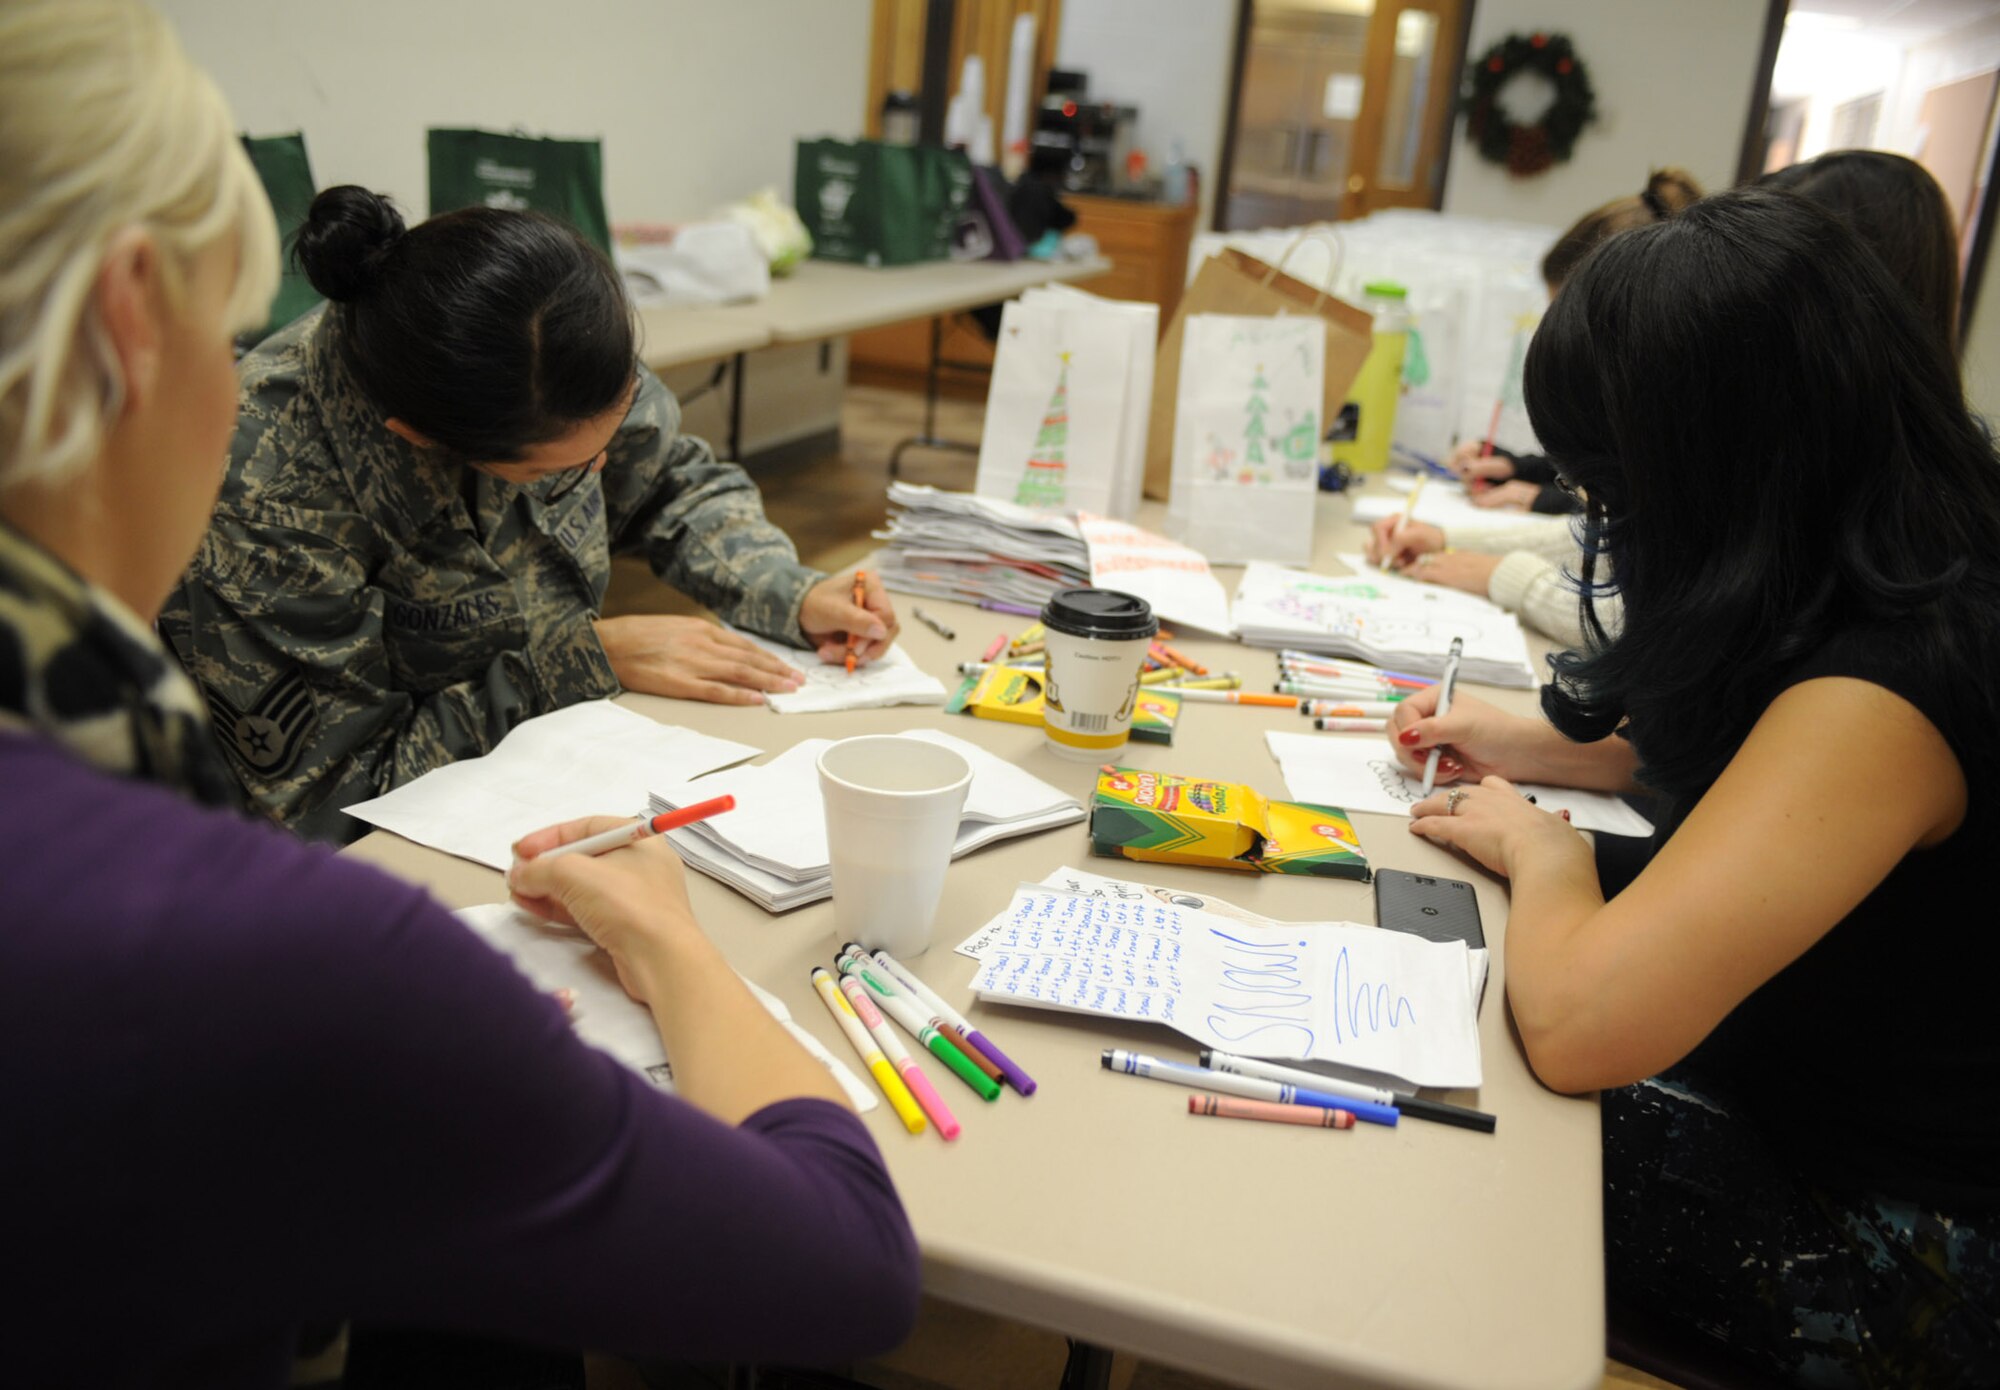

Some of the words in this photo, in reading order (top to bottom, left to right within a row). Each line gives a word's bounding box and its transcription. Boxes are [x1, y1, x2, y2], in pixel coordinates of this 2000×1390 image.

[394, 592, 500, 631] GONZALES
[1134, 773, 1156, 806] CRAYONS
[1212, 784, 1229, 814] Crayola
